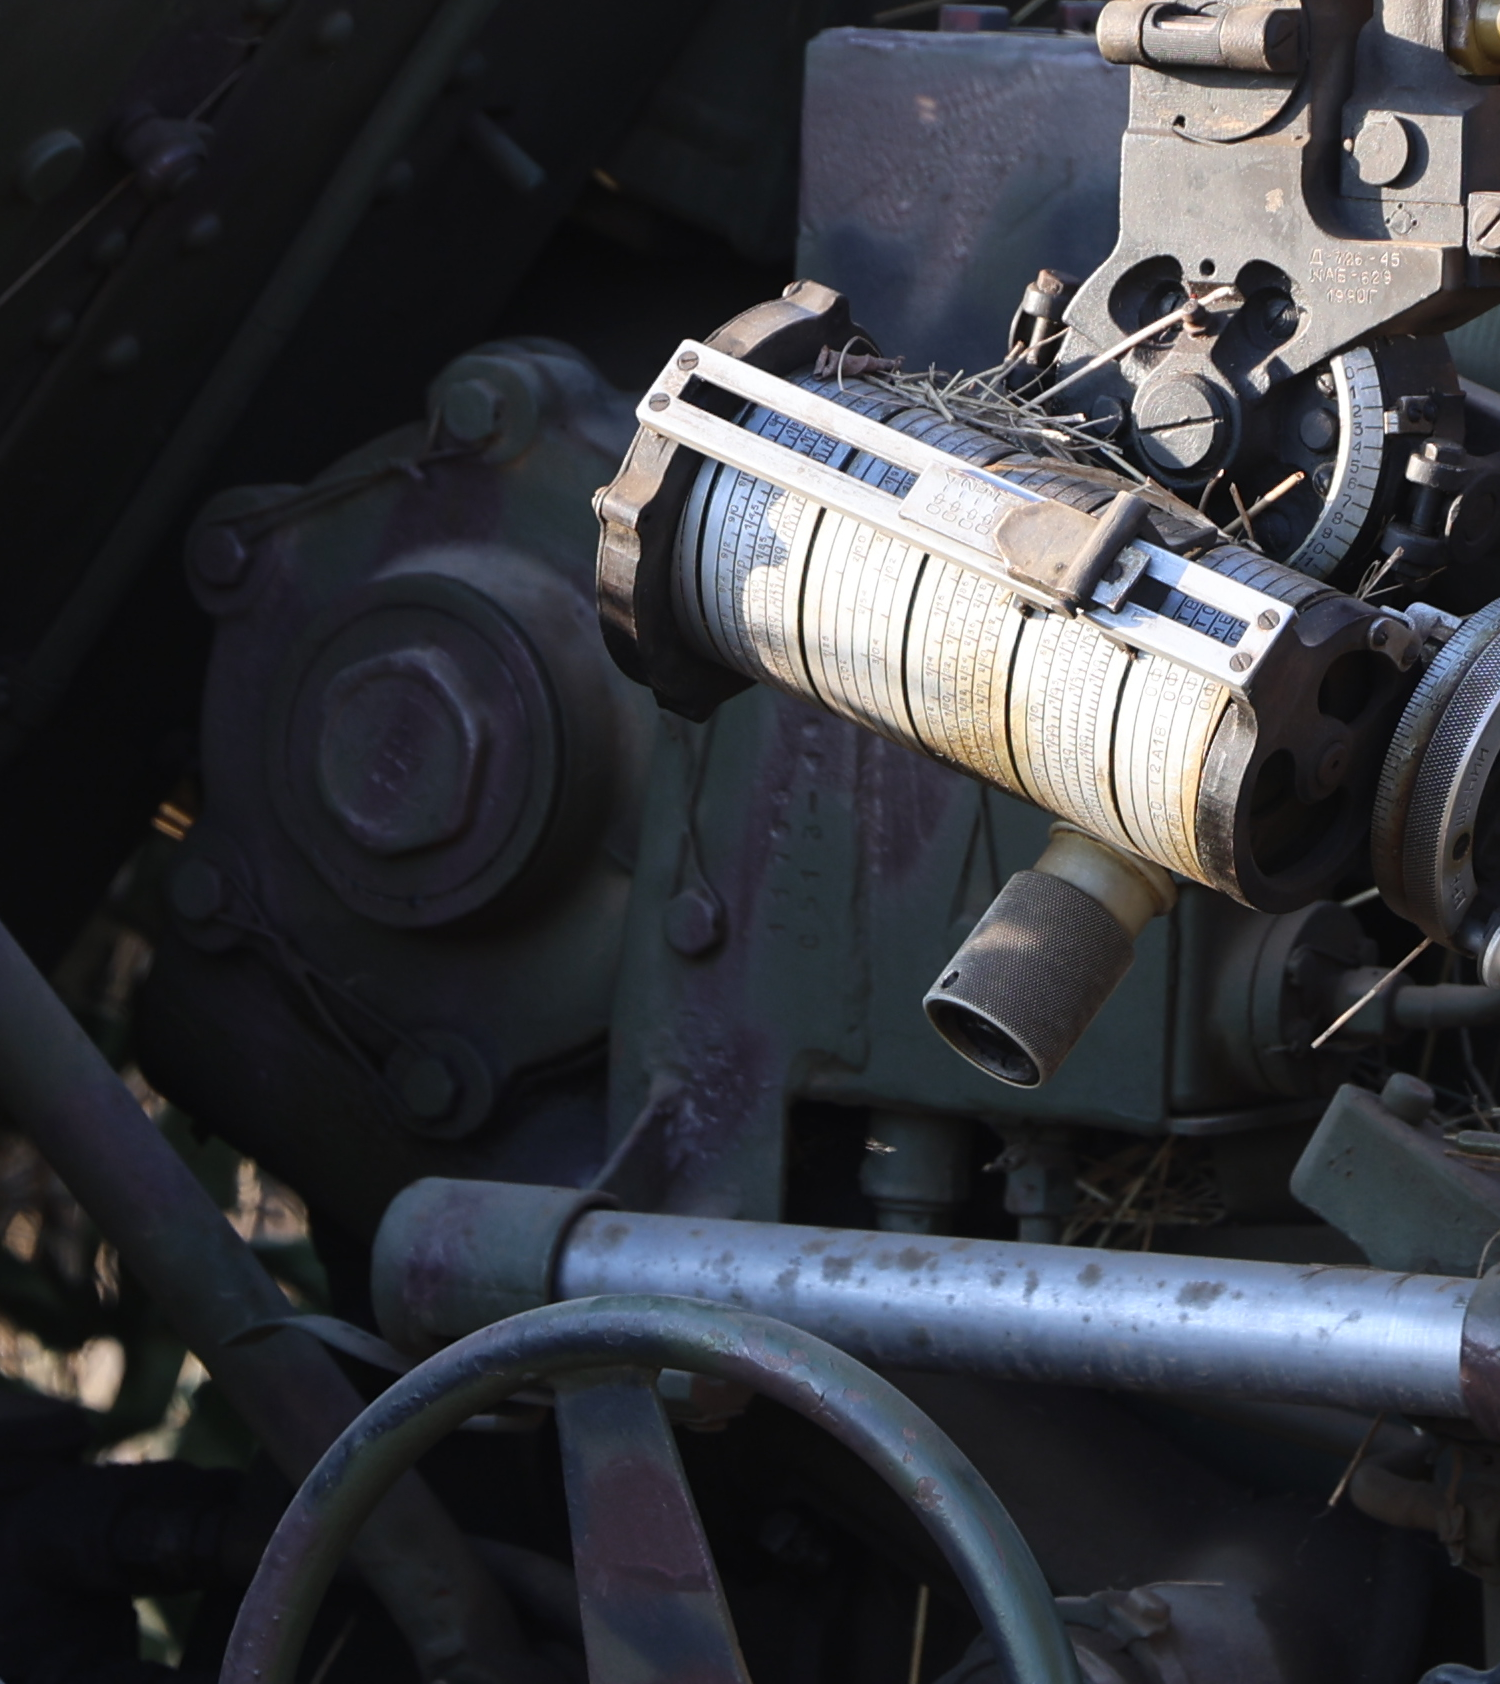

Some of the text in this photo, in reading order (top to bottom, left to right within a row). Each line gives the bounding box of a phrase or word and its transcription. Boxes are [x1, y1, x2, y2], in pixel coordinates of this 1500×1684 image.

[1349, 386, 1357, 399] 1
[1352, 404, 1362, 418] 2
[1352, 422, 1364, 437] 3
[1351, 441, 1363, 455] 4
[1349, 459, 1360, 473] 5
[1347, 477, 1358, 490] 6
[1341, 494, 1353, 508] 7
[1331, 511, 1344, 525] 8
[720, 540, 731, 559] 92
[727, 504, 739, 523] 90
[852, 534, 866, 562] 200
[1307, 538, 1326, 555] 10
[883, 557, 897, 583] 302
[972, 583, 988, 609] 238
[946, 620, 957, 645] 184
[956, 579, 969, 606] 186
